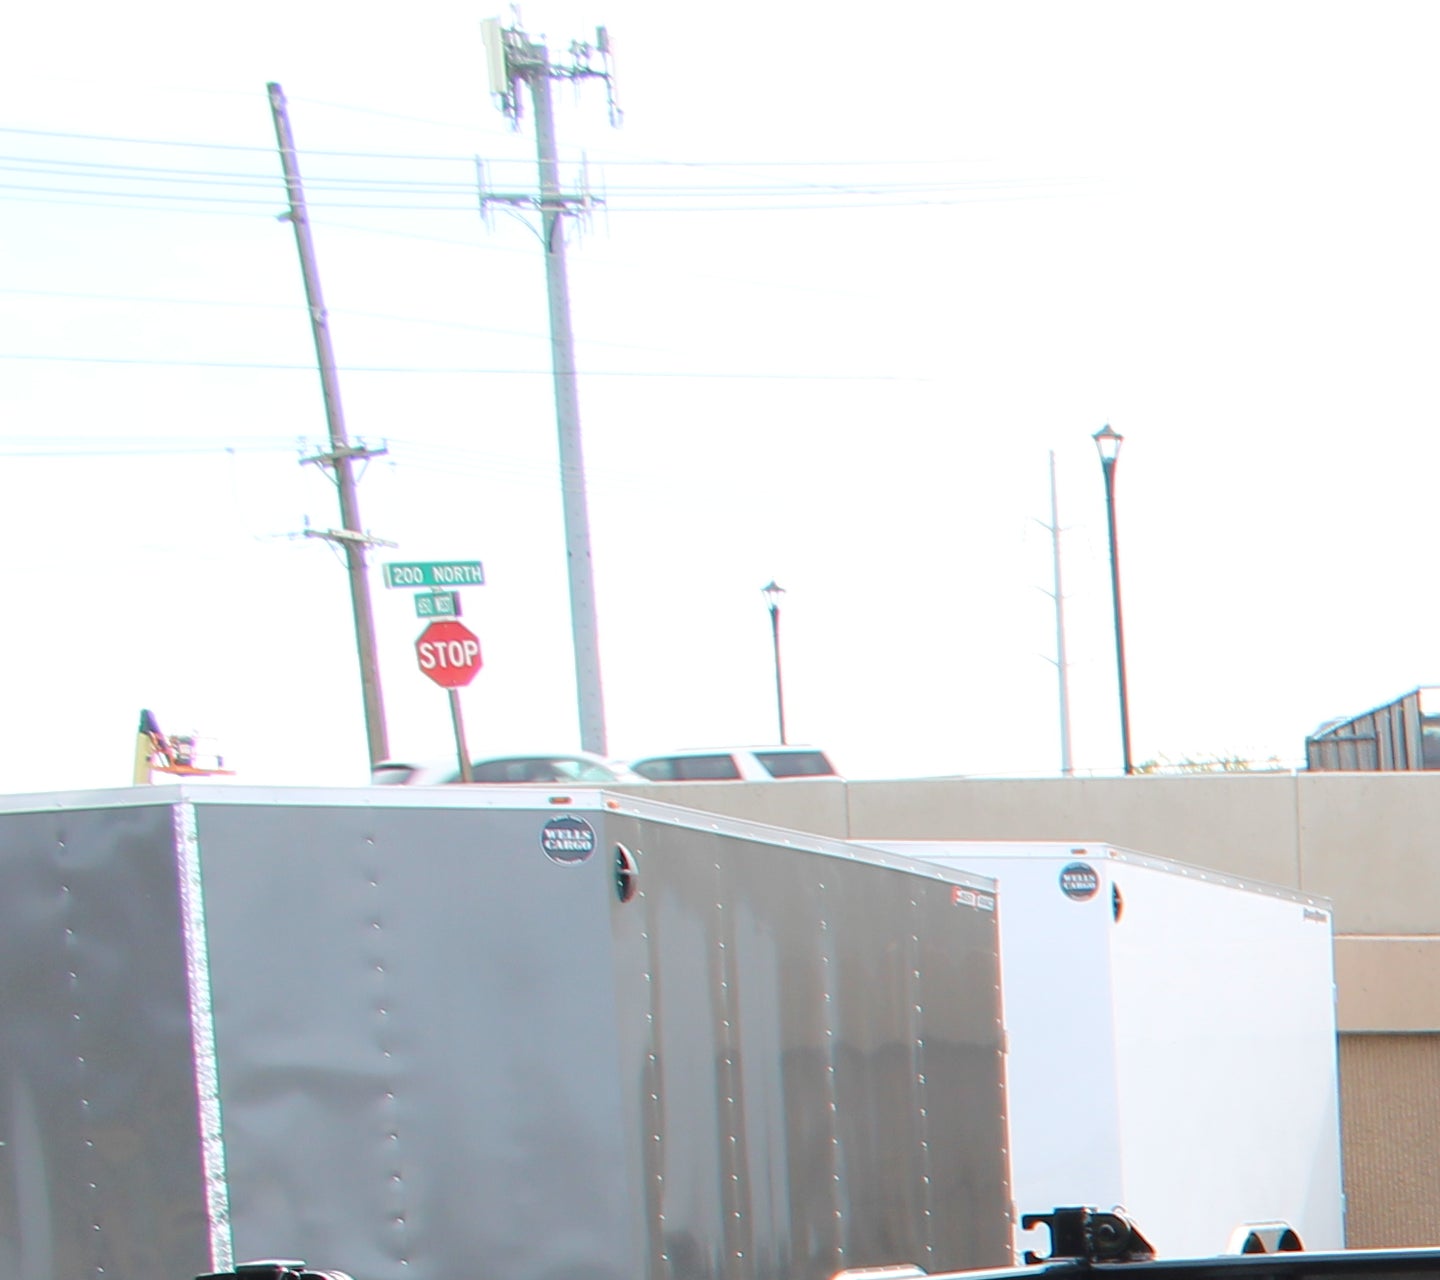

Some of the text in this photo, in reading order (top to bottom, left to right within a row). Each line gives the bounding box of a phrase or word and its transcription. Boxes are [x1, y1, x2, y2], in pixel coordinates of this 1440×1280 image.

[393, 565, 483, 584] 200 NORTH
[419, 640, 478, 669] STOP
[544, 829, 592, 840] WELLS
[544, 840, 593, 850] CARGO
